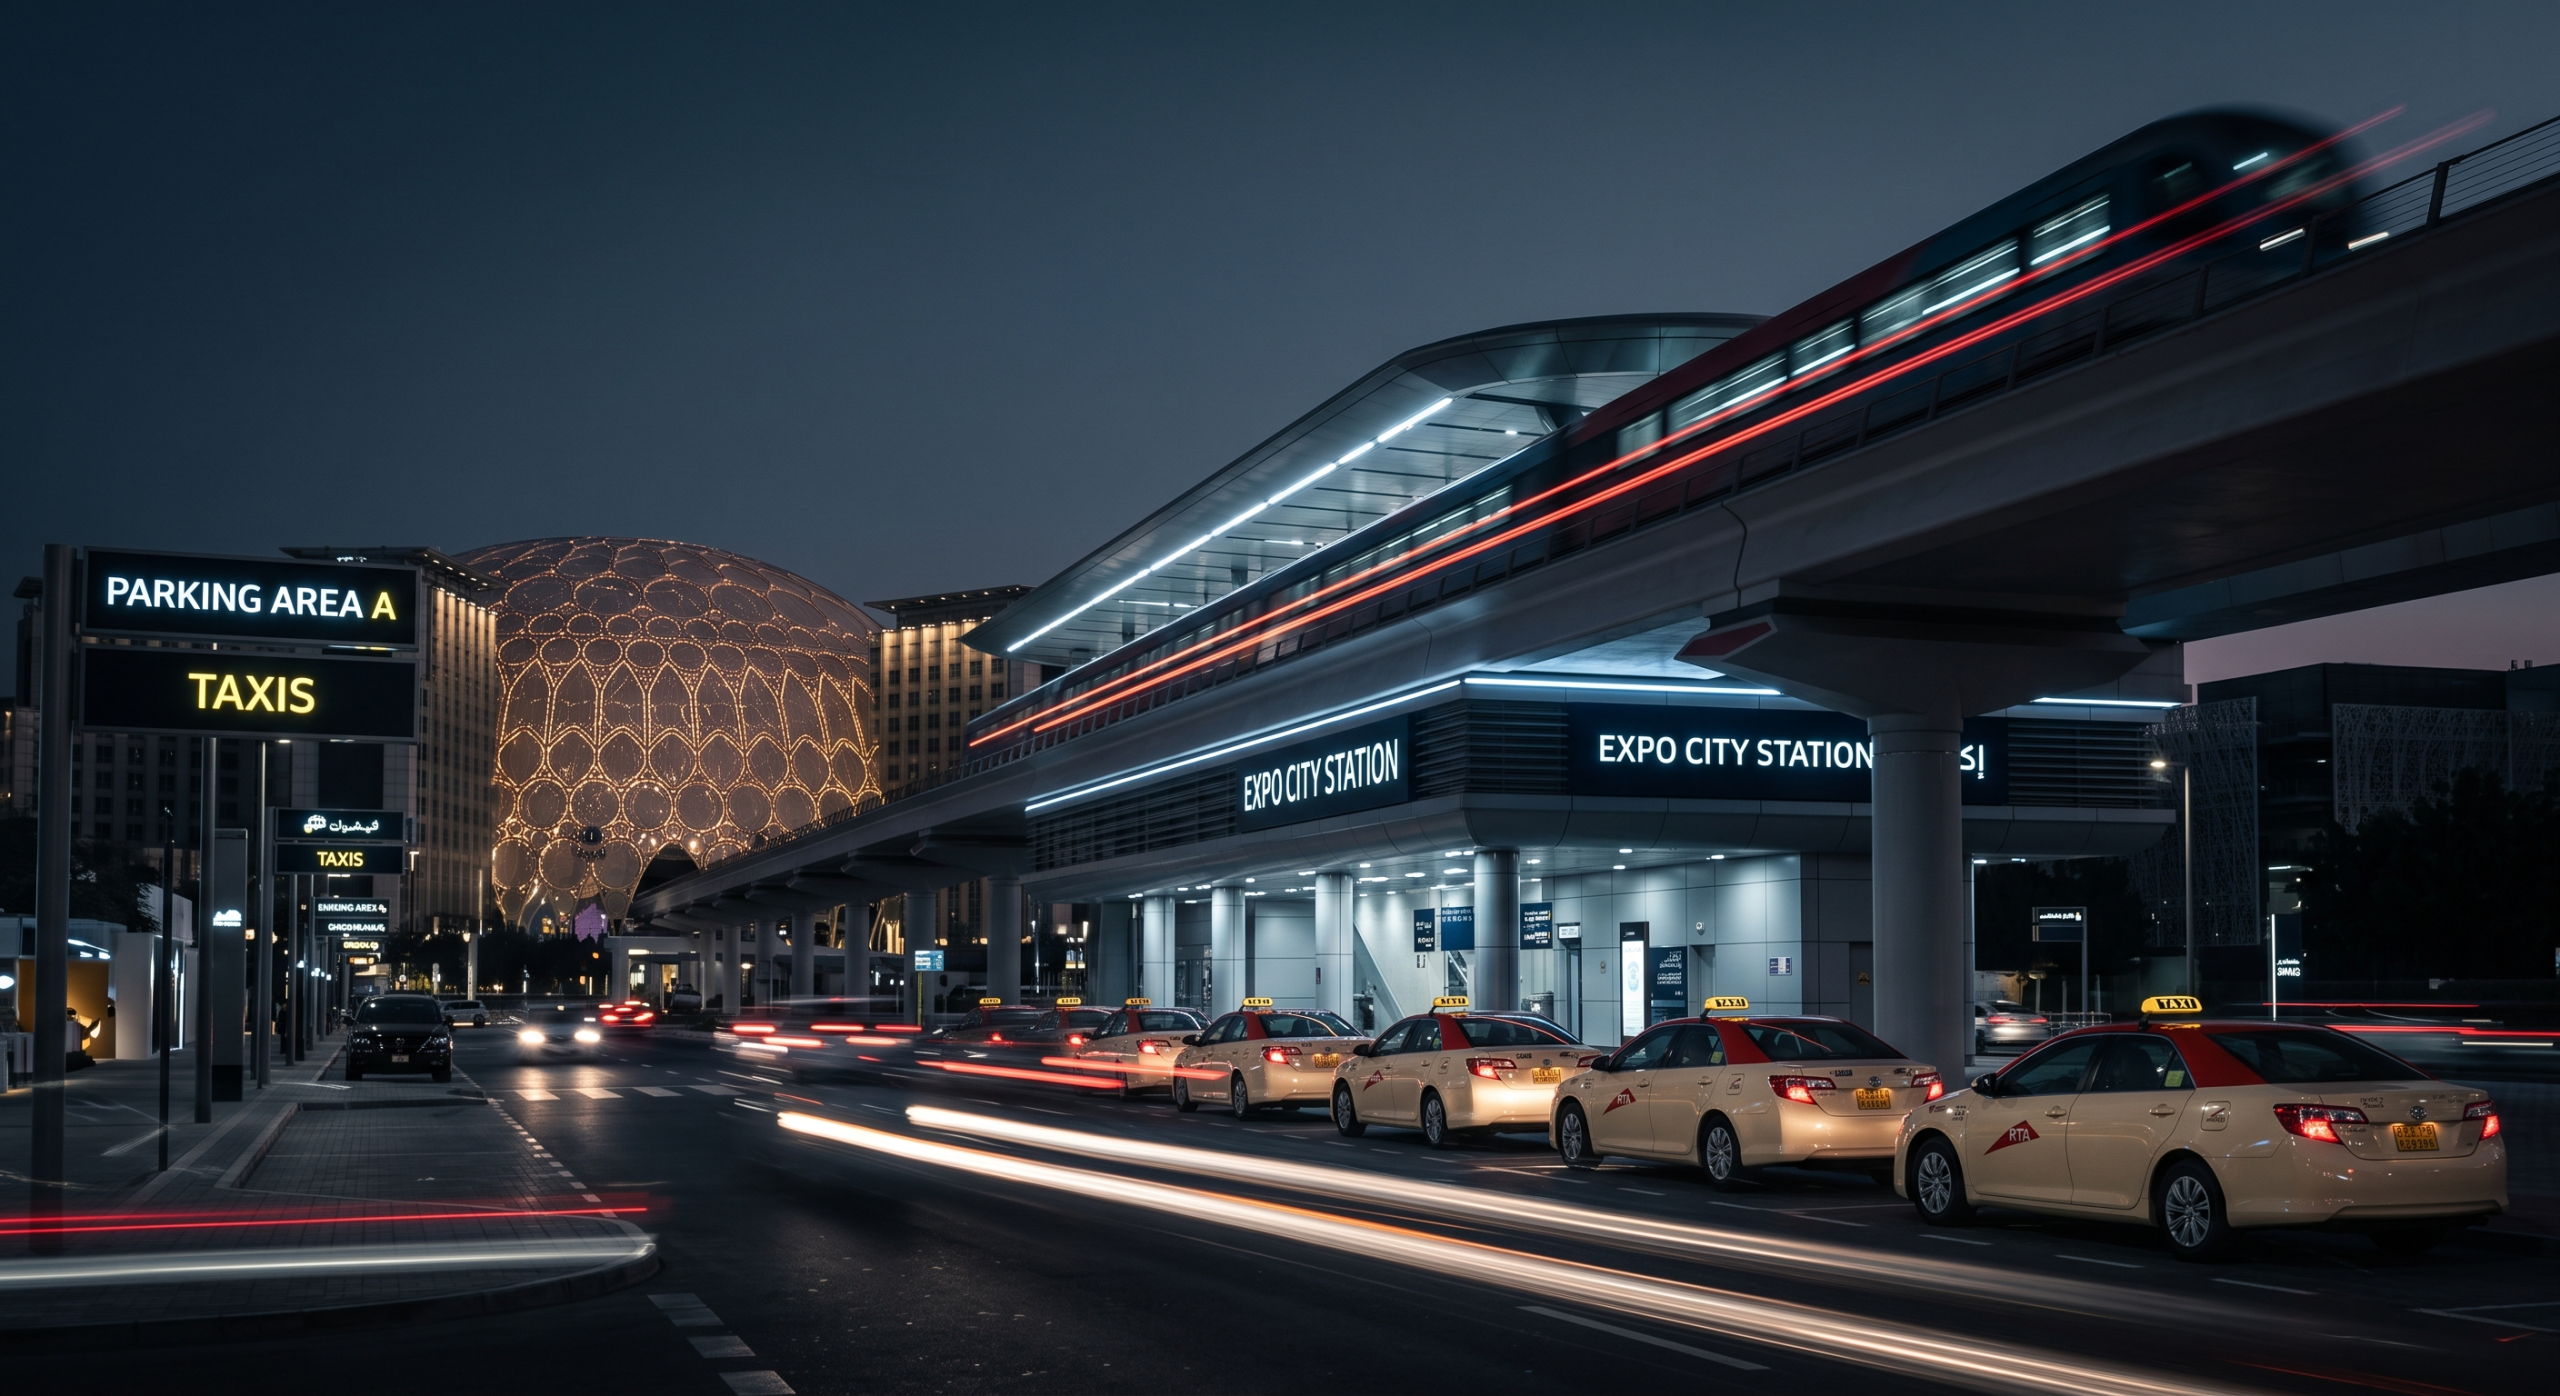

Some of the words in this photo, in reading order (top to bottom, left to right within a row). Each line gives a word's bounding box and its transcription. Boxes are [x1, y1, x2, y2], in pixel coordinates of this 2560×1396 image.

[108, 577, 261, 613] PARKING
[271, 586, 363, 618] AREA
[372, 592, 396, 620] A
[189, 673, 314, 713] TAXIS
[1600, 734, 1676, 763] EXPO
[1685, 736, 1749, 765] CITY
[1756, 739, 1873, 769] STATION
[1245, 768, 1283, 811] EXPO
[1286, 758, 1321, 802] CITY
[1325, 739, 1398, 794] STATION
[317, 851, 364, 867] TAXIS
[2160, 999, 2193, 1009] TAXI
[1617, 1094, 1631, 1104] RTA
[2009, 1128, 2030, 1141] RTA
